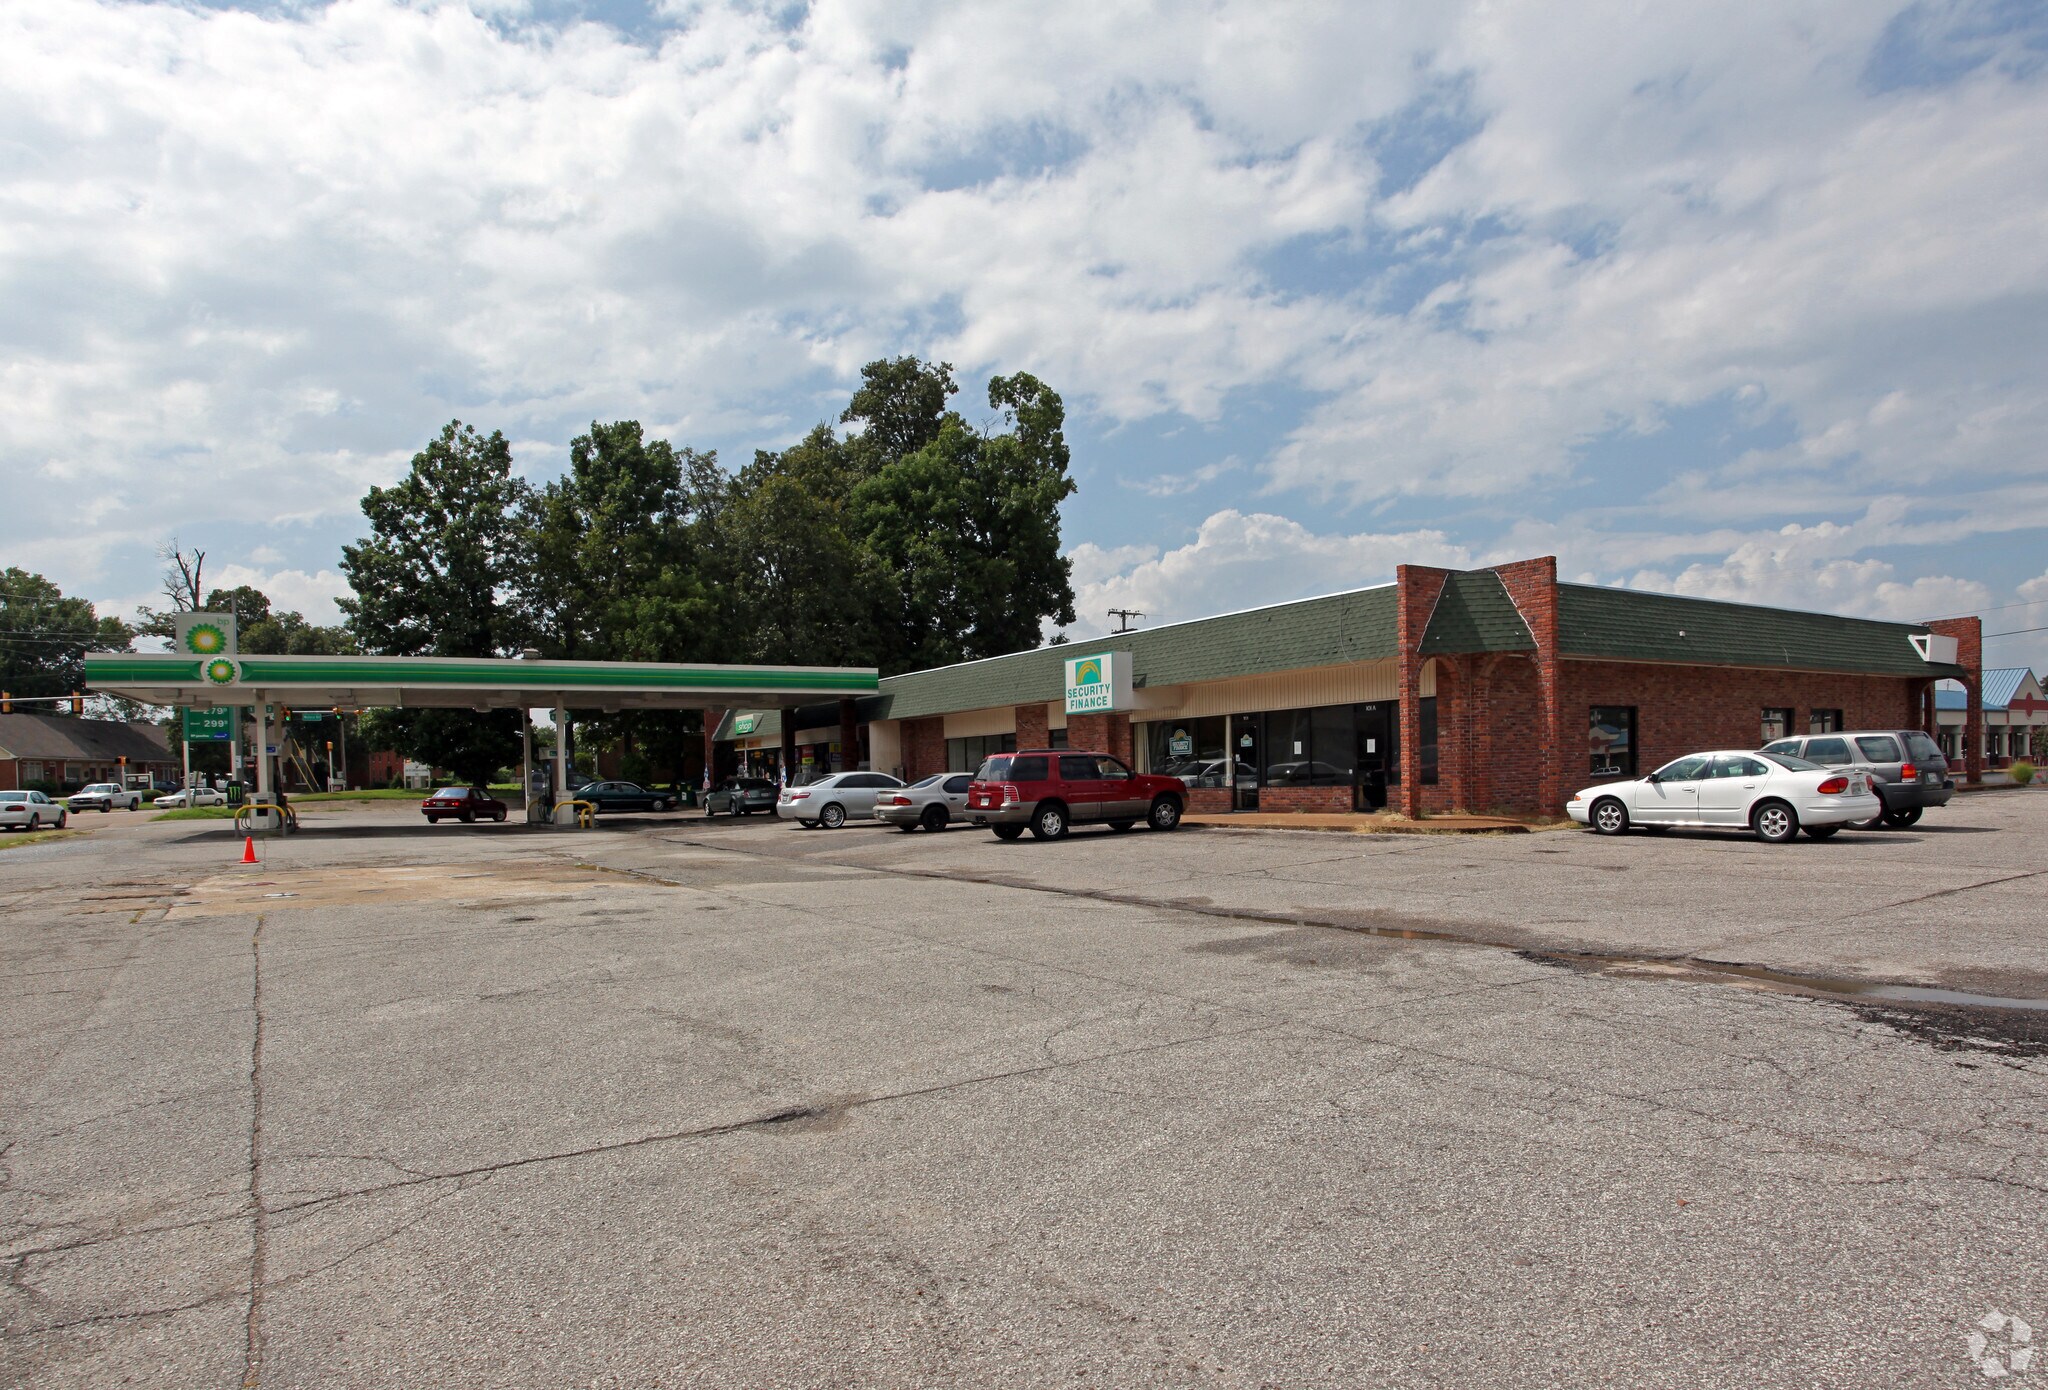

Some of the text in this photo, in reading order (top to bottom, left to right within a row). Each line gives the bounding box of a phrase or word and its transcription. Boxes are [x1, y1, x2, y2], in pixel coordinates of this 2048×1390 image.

[217, 617, 229, 626] bp
[1067, 684, 1110, 698] SECURITY
[1070, 696, 1107, 709] FINANCE
[738, 721, 752, 731] shop
